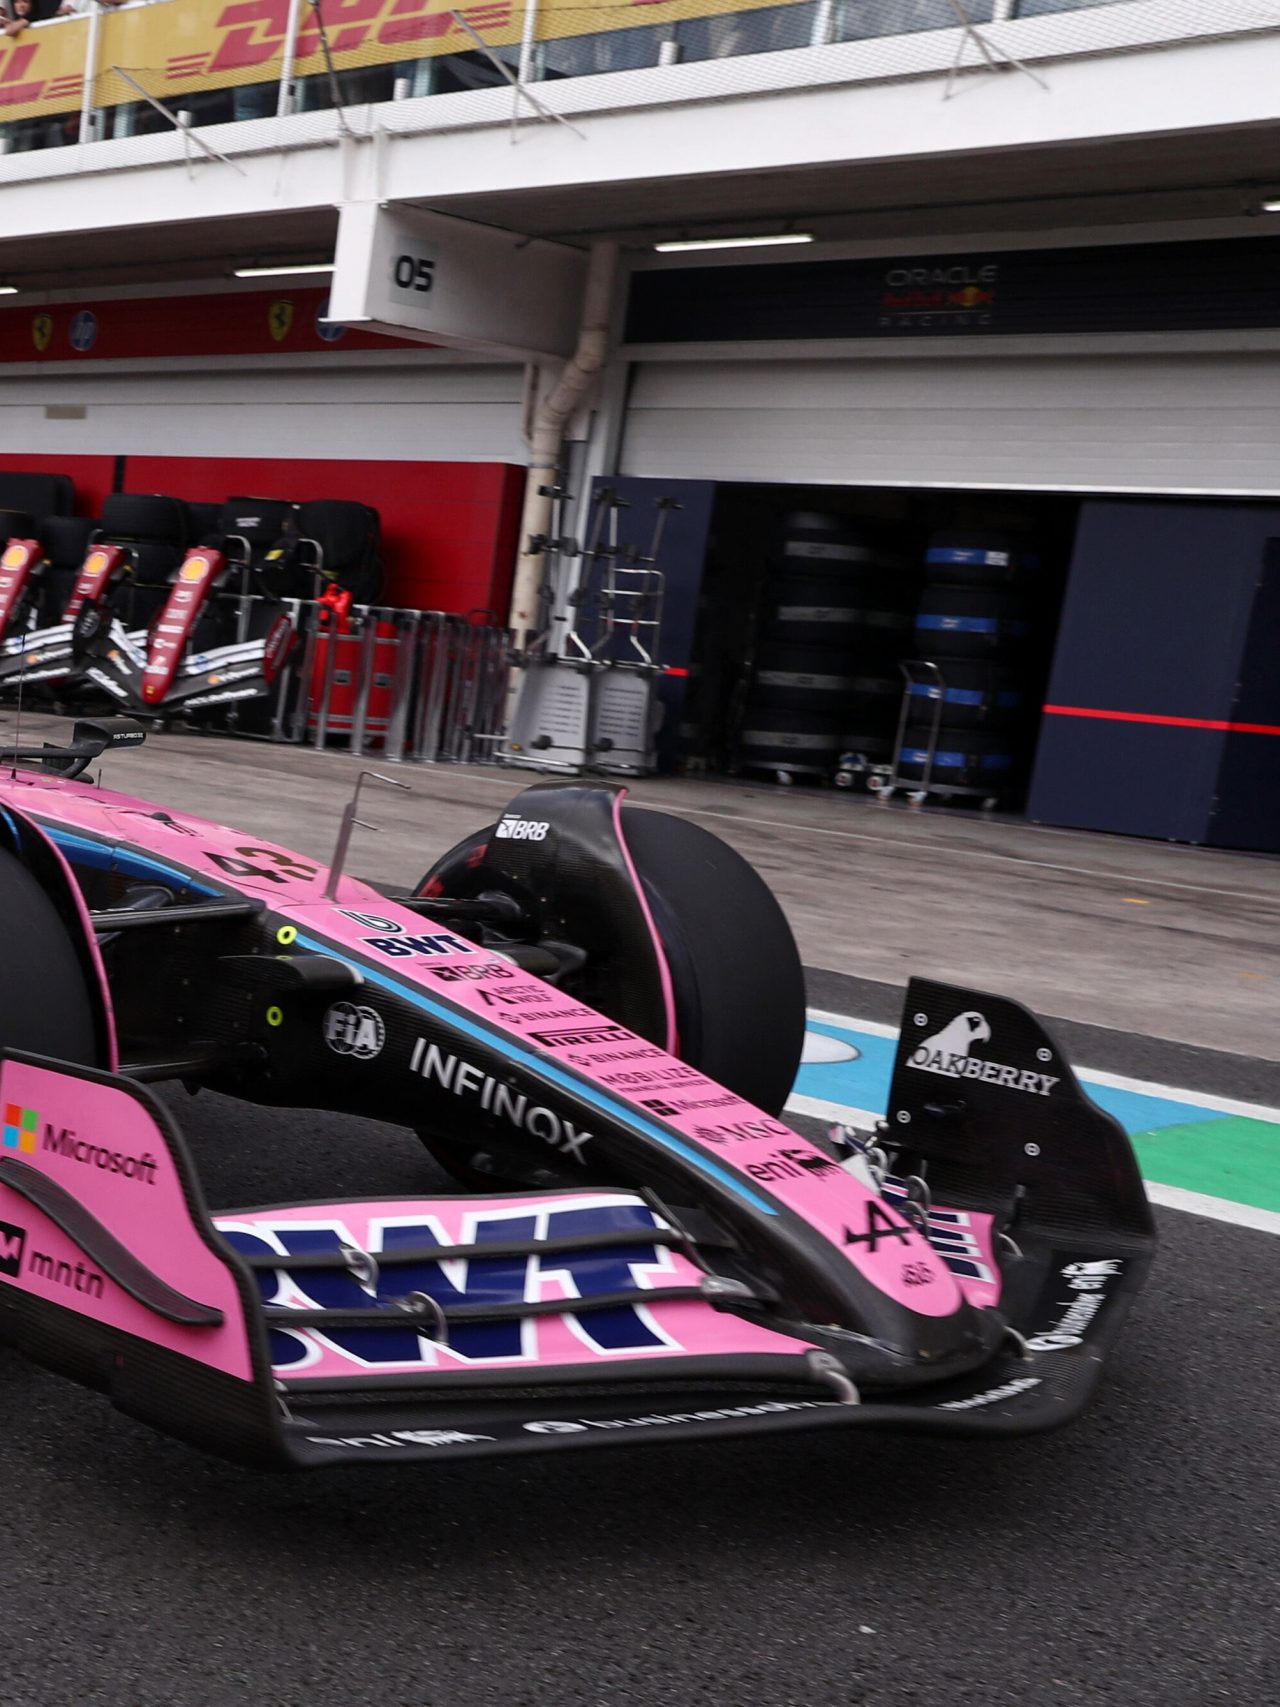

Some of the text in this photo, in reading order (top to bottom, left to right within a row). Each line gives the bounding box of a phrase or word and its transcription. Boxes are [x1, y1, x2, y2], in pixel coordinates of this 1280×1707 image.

[395, 254, 433, 292] 05
[886, 265, 998, 287] ORACLE
[512, 820, 550, 841] BRB
[201, 846, 318, 884] 43
[359, 934, 477, 958] BWT
[455, 964, 515, 980] BRB
[523, 1007, 598, 1022] BINANCE
[526, 1025, 638, 1047] PIRELLI
[593, 1048, 668, 1063] BINANCE
[907, 1044, 1061, 1097] OAKBERRY
[409, 1036, 594, 1166] INFINOX
[722, 1118, 793, 1142] MSC
[42, 1122, 158, 1186] Microsoft
[744, 1153, 804, 1182] eni
[28, 1250, 106, 1300] mntn
